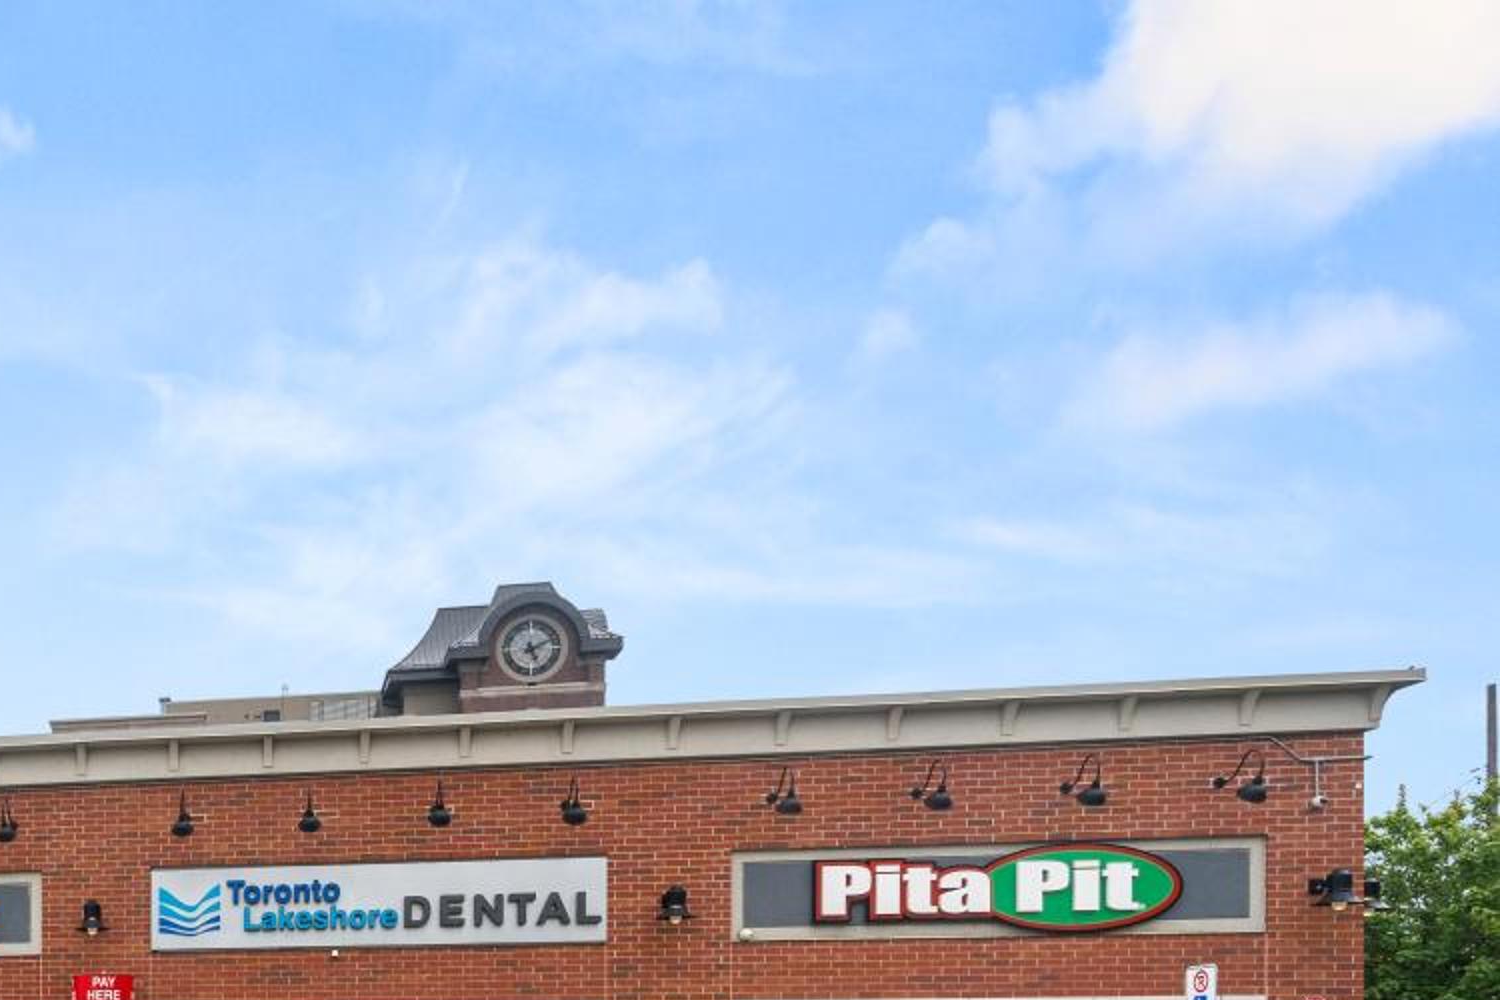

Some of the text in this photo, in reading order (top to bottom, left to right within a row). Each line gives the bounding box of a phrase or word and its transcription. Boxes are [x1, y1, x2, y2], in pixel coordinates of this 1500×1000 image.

[226, 879, 341, 905] Toronto
[820, 860, 1140, 916] Pita Pit
[243, 891, 602, 932] Lakeshore DENTAL
[87, 989, 122, 1000] HERE
[92, 976, 116, 988] PAY
